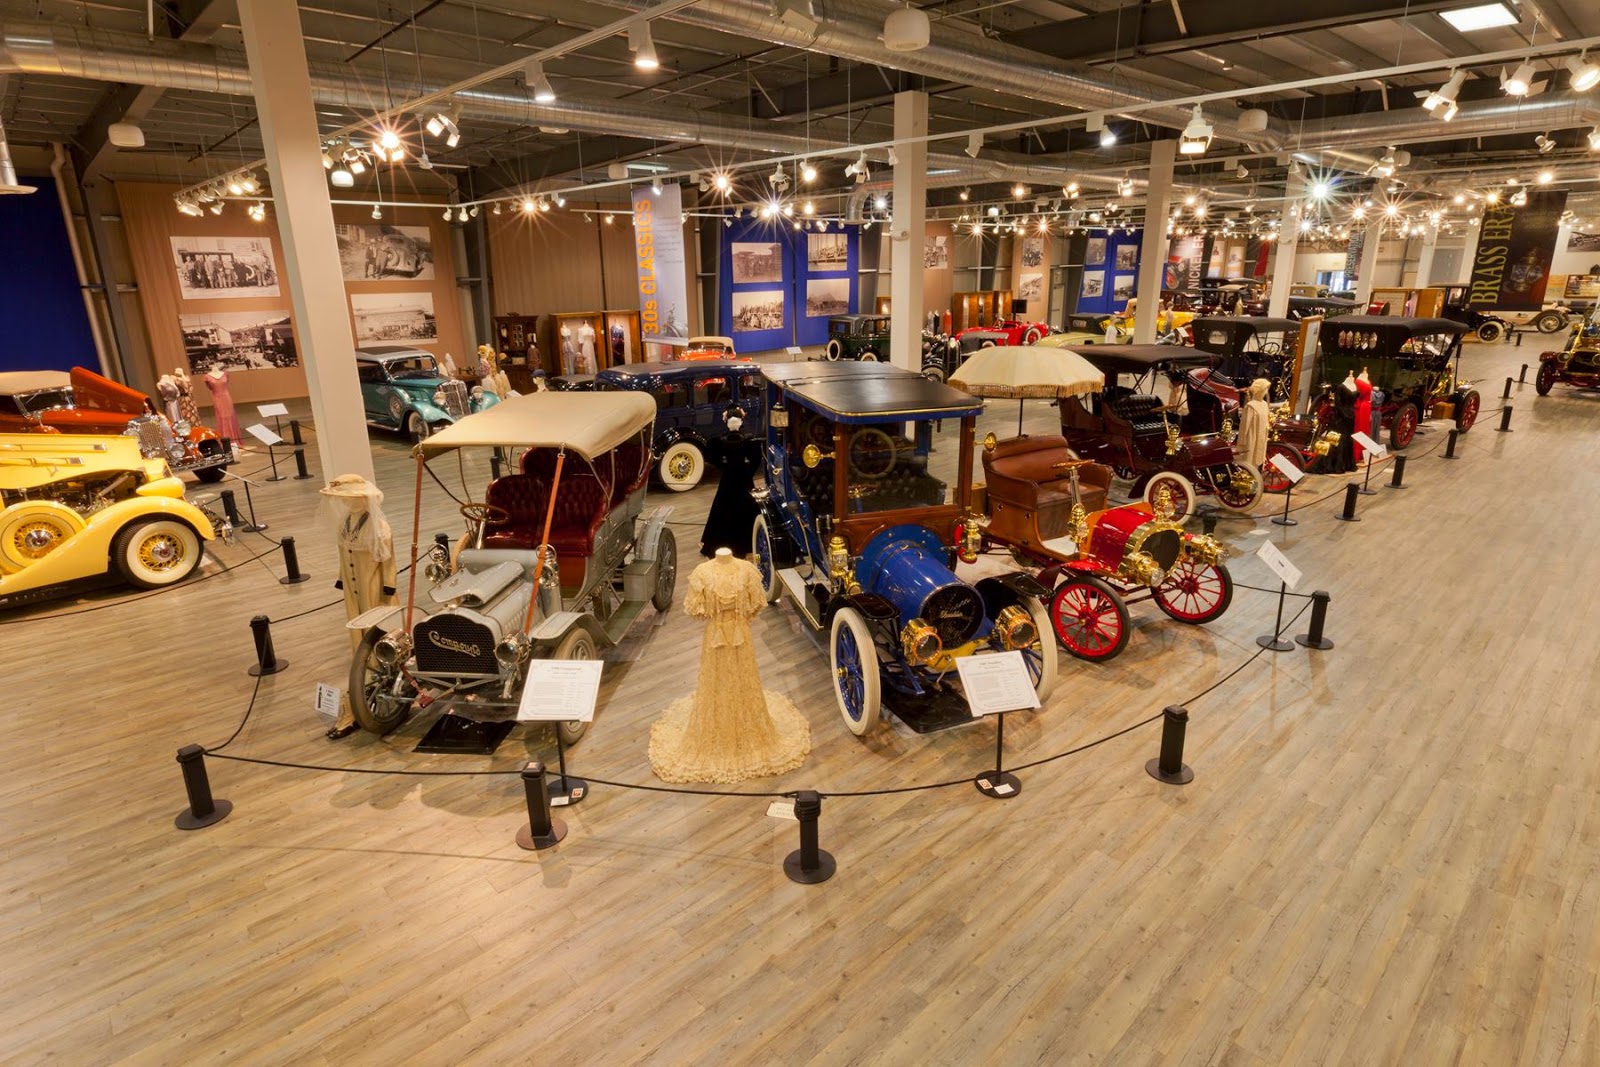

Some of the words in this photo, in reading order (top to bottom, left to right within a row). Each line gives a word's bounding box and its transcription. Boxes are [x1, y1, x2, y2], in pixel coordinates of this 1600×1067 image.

[635, 198, 657, 296] CLASSICS
[1187, 250, 1204, 290] NICKEL
[1469, 245, 1509, 304] BRASS
[641, 299, 660, 336] 30s
